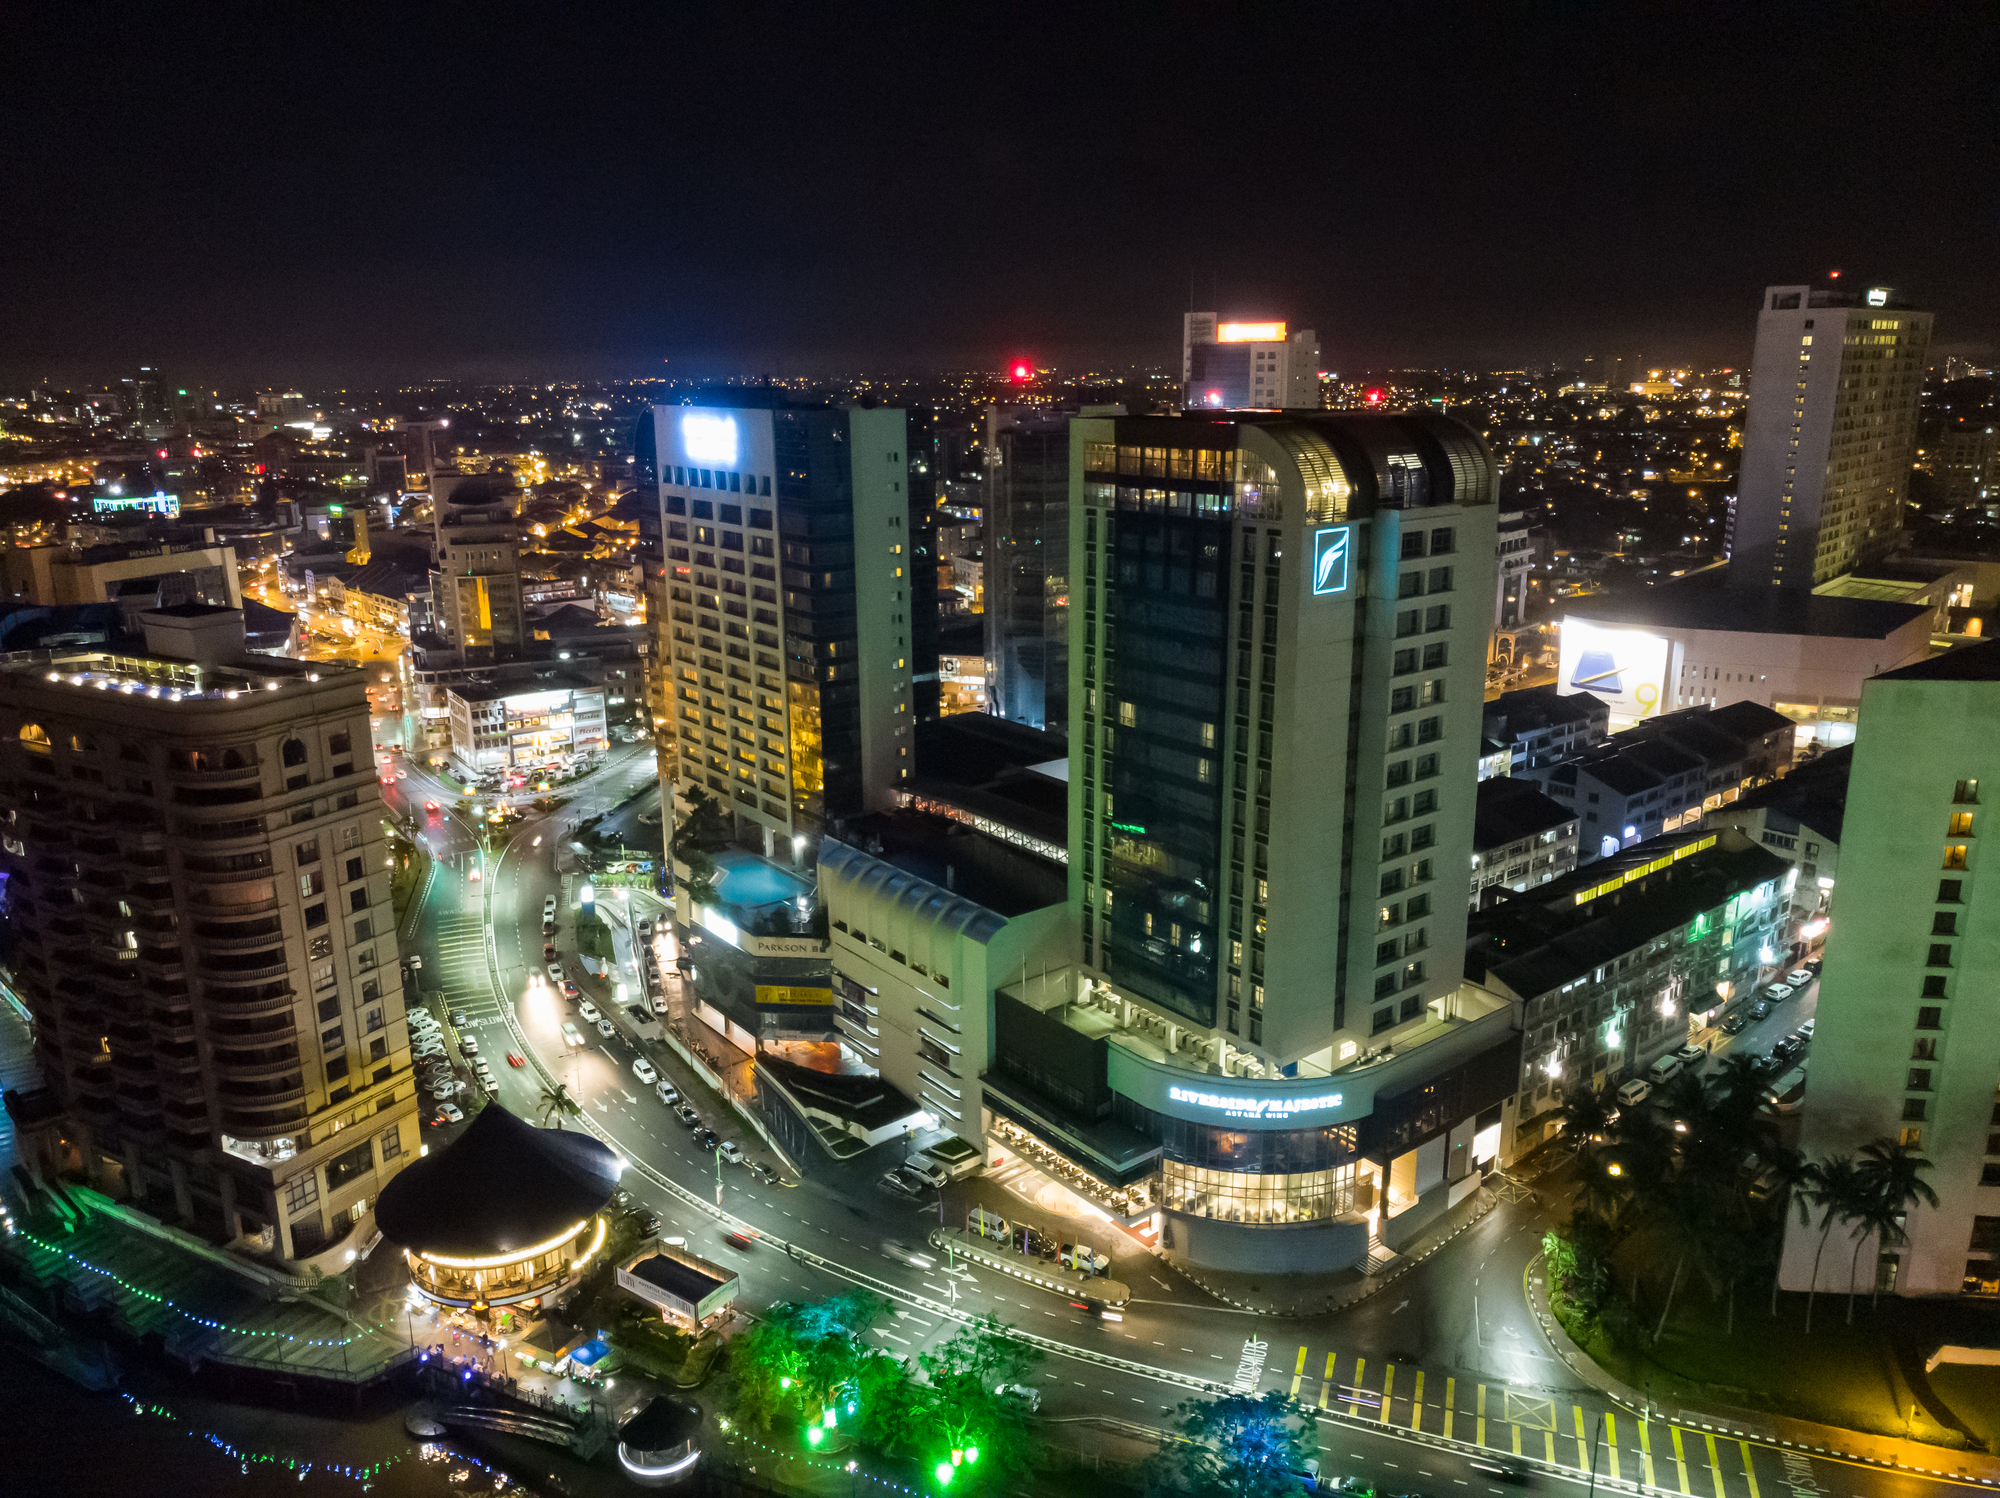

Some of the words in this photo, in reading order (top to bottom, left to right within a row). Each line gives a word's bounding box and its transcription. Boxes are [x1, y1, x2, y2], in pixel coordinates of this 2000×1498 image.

[129, 547, 161, 558] MENARA
[1635, 683, 1659, 715] 9
[758, 942, 807, 952] PARKSON
[1169, 1086, 1257, 1112] RIVERSIDE
[1268, 1093, 1343, 1113] MAJESTIC
[1225, 1109, 1262, 1119] ASTANA
